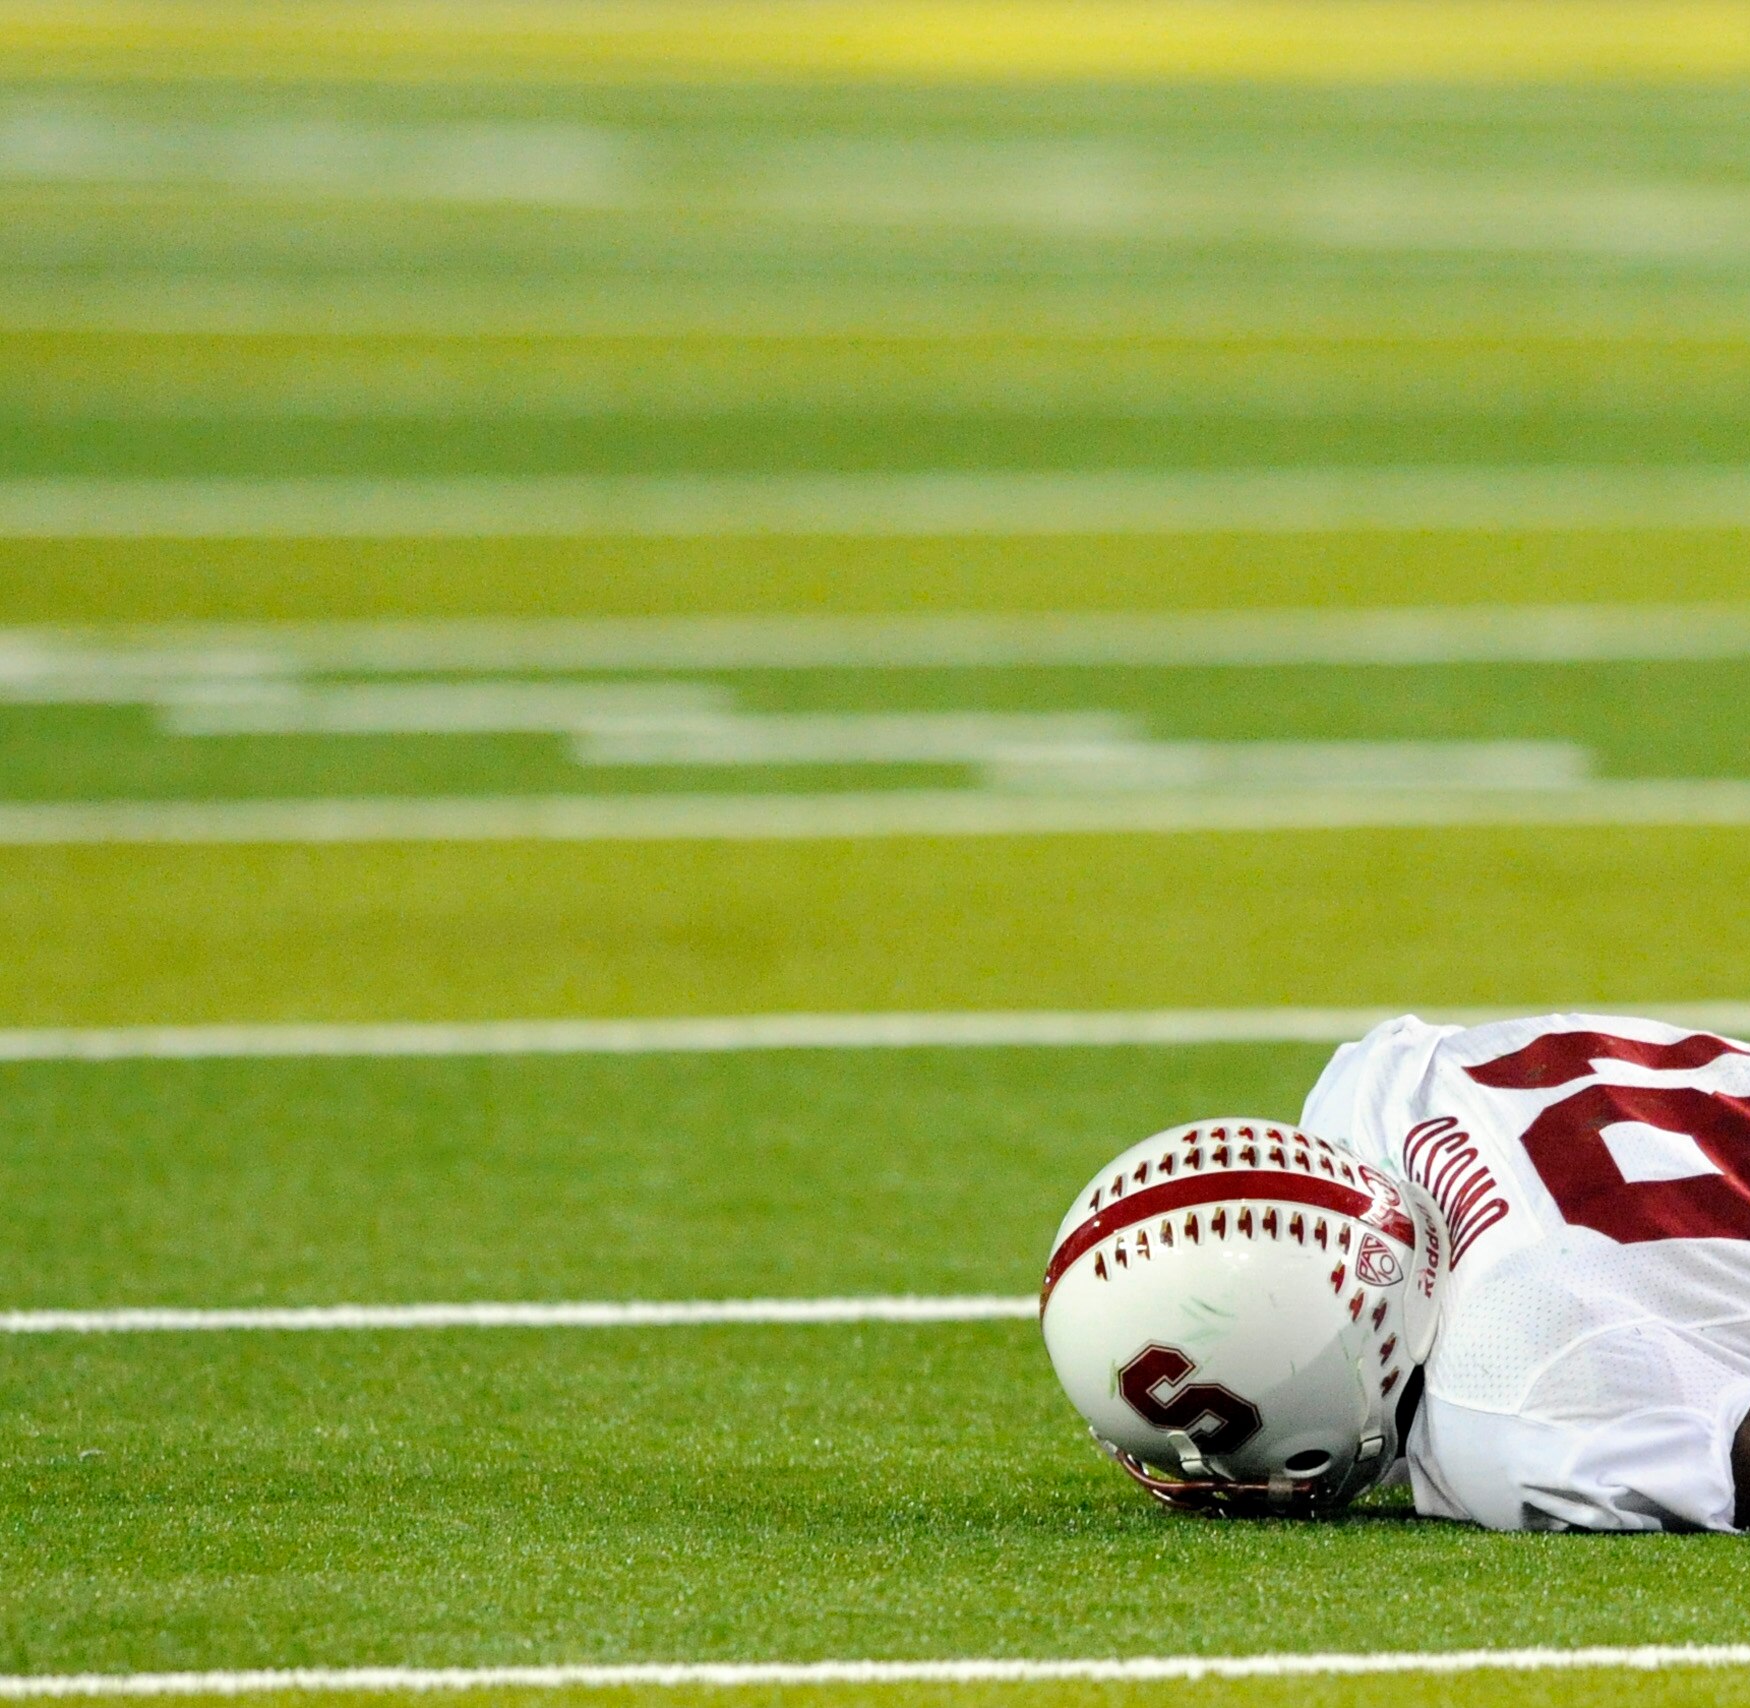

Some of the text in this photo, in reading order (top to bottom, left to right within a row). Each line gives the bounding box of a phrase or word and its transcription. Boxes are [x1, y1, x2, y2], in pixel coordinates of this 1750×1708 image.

[1358, 1235, 1388, 1283] PAC
[1377, 1254, 1396, 1281] 10
[1118, 1344, 1263, 1455] S
